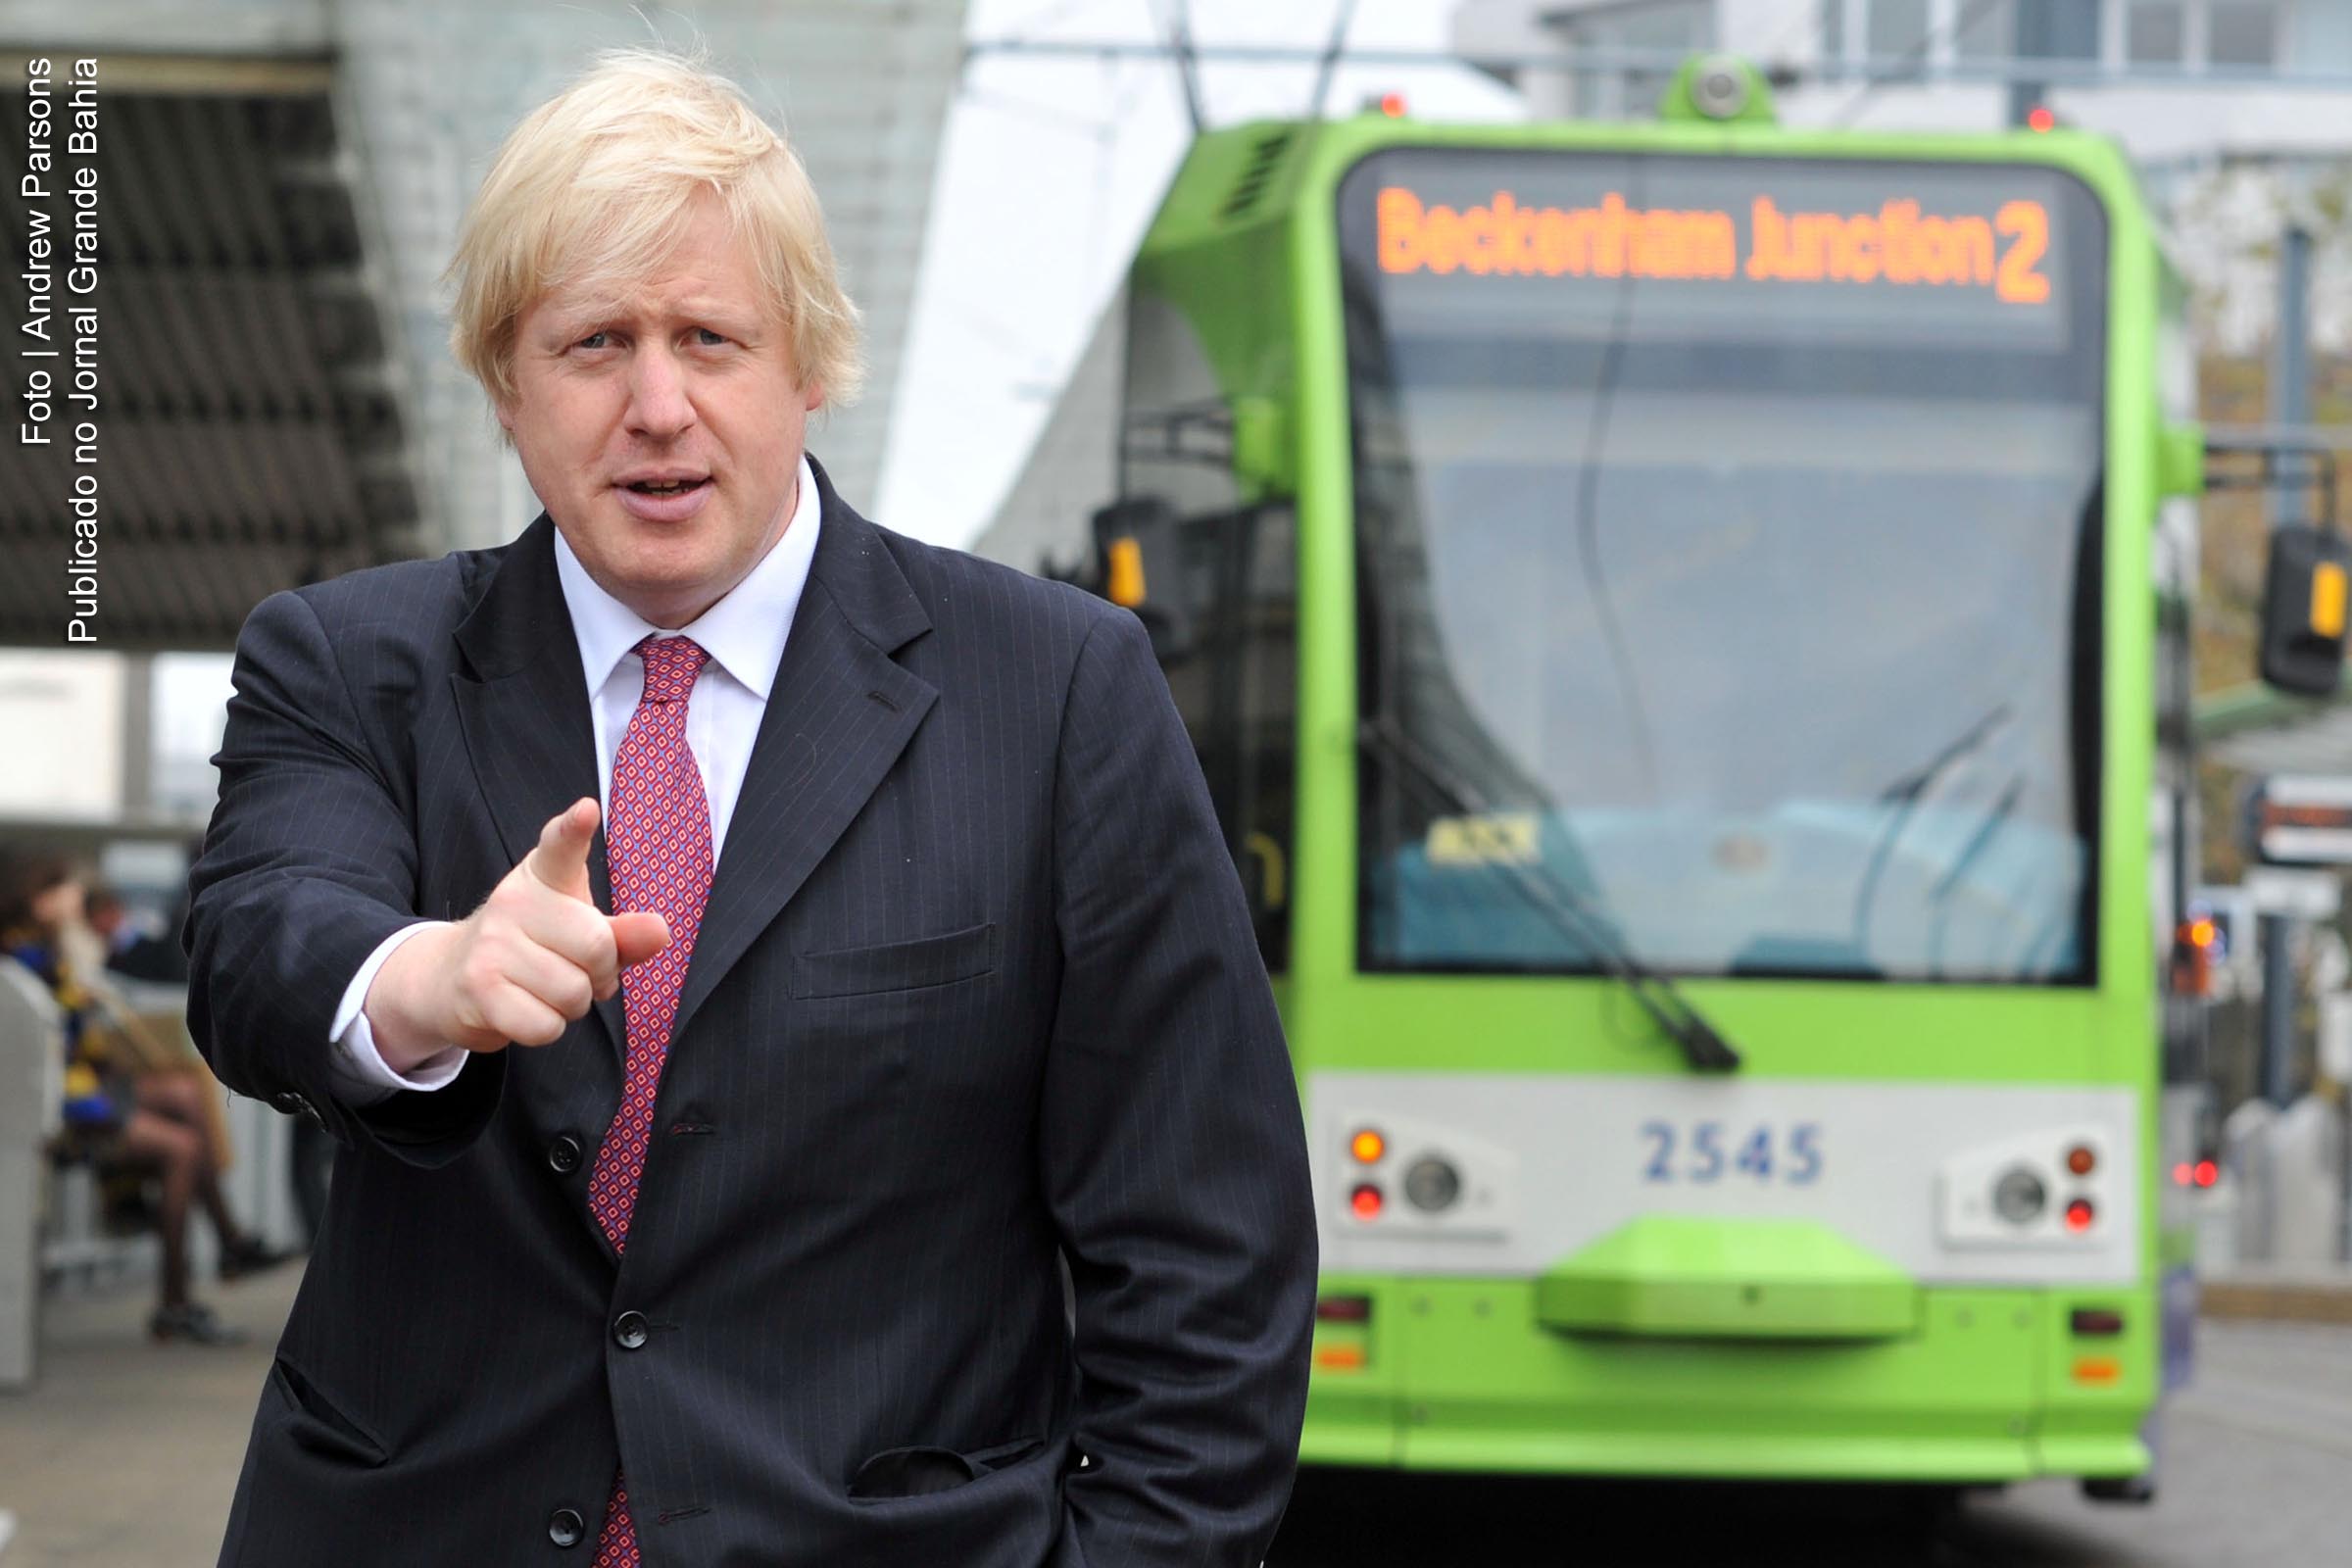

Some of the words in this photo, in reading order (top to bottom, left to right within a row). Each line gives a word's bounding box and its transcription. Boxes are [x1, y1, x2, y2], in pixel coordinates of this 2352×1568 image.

[1376, 186, 1737, 278] Beckenham
[1746, 194, 1994, 285] Junction
[1995, 199, 2051, 304] 2
[1640, 1121, 1824, 1184] 2545
